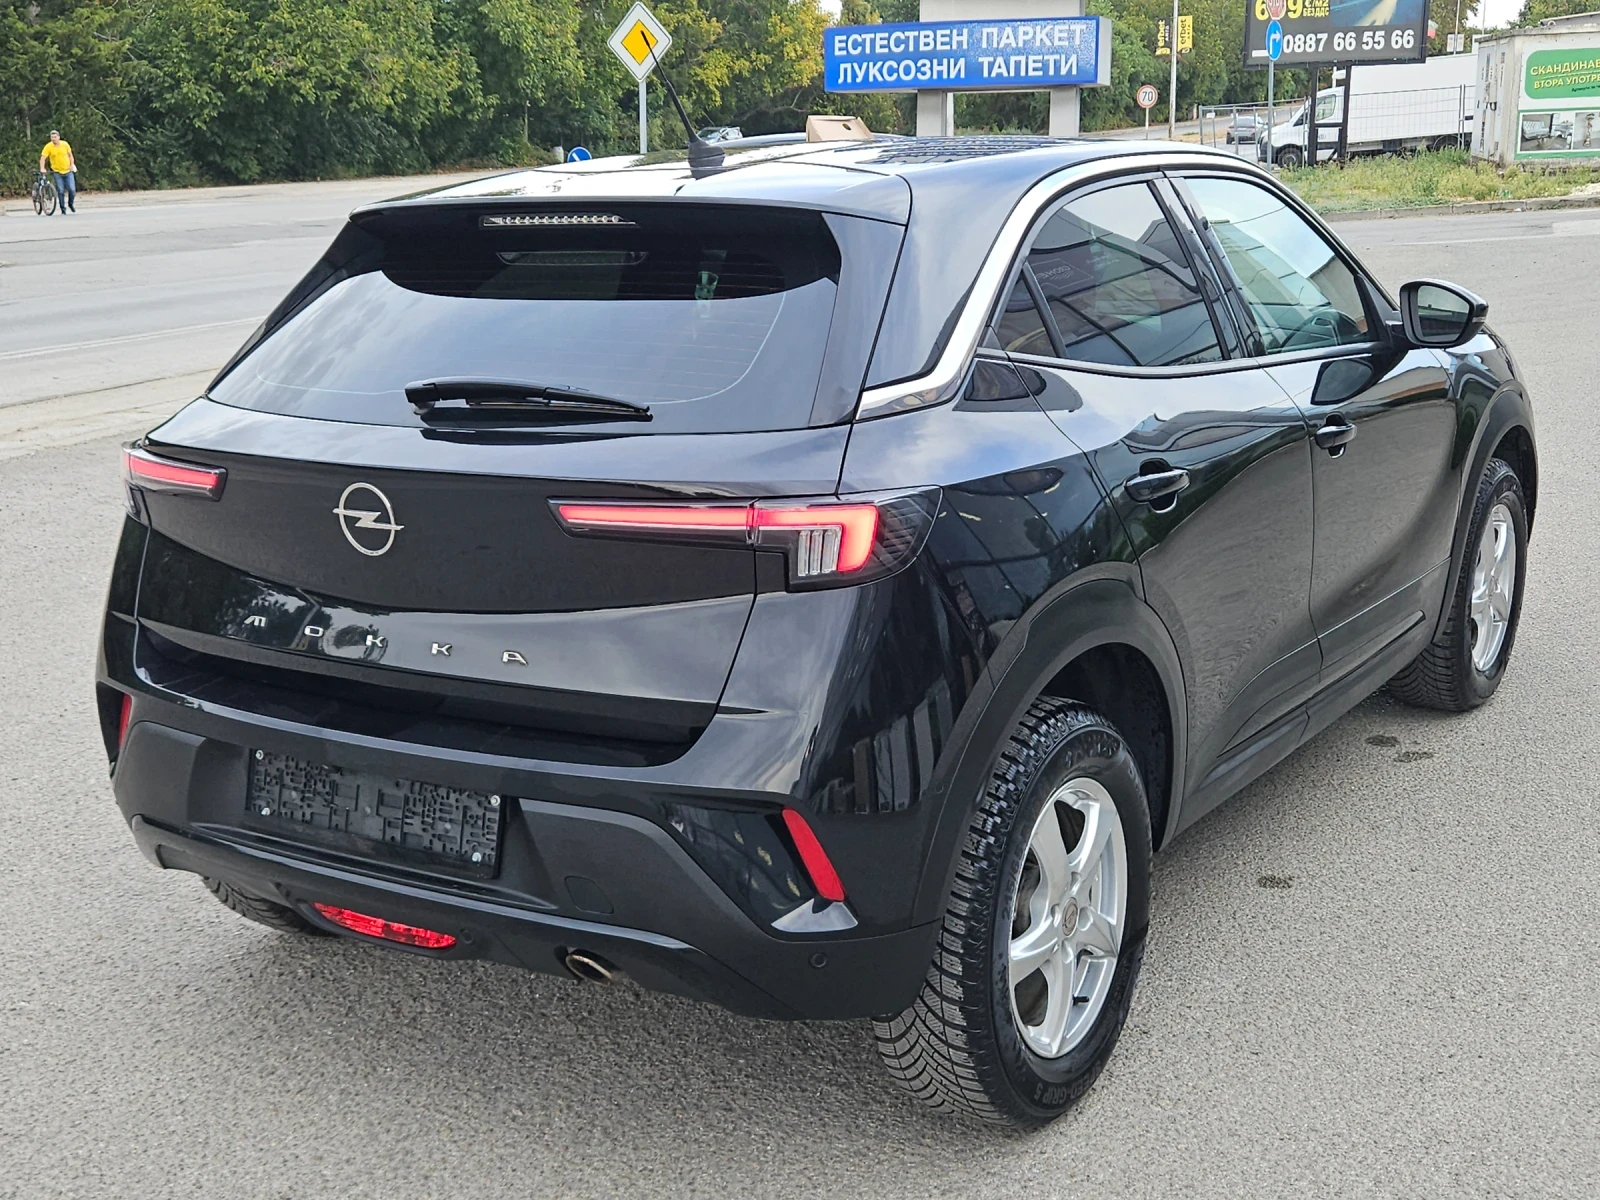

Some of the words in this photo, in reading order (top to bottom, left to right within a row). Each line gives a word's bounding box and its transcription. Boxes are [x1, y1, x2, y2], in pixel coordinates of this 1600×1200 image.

[834, 28, 968, 56] ЕСТЕСТВЕН
[981, 24, 1087, 49] ПАРКЕТ
[1179, 18, 1187, 45] efbet
[1282, 33, 1328, 53] 0887
[1333, 31, 1357, 51] 66
[1361, 30, 1385, 51] 55
[1390, 29, 1415, 49] 66
[837, 57, 966, 84] ЛУКСОЗНИ
[978, 54, 1078, 78] ТАПЕТИ
[1142, 90, 1154, 102] 70
[1534, 78, 1564, 89] ВТОРА
[243, 614, 529, 667] MOKKA
